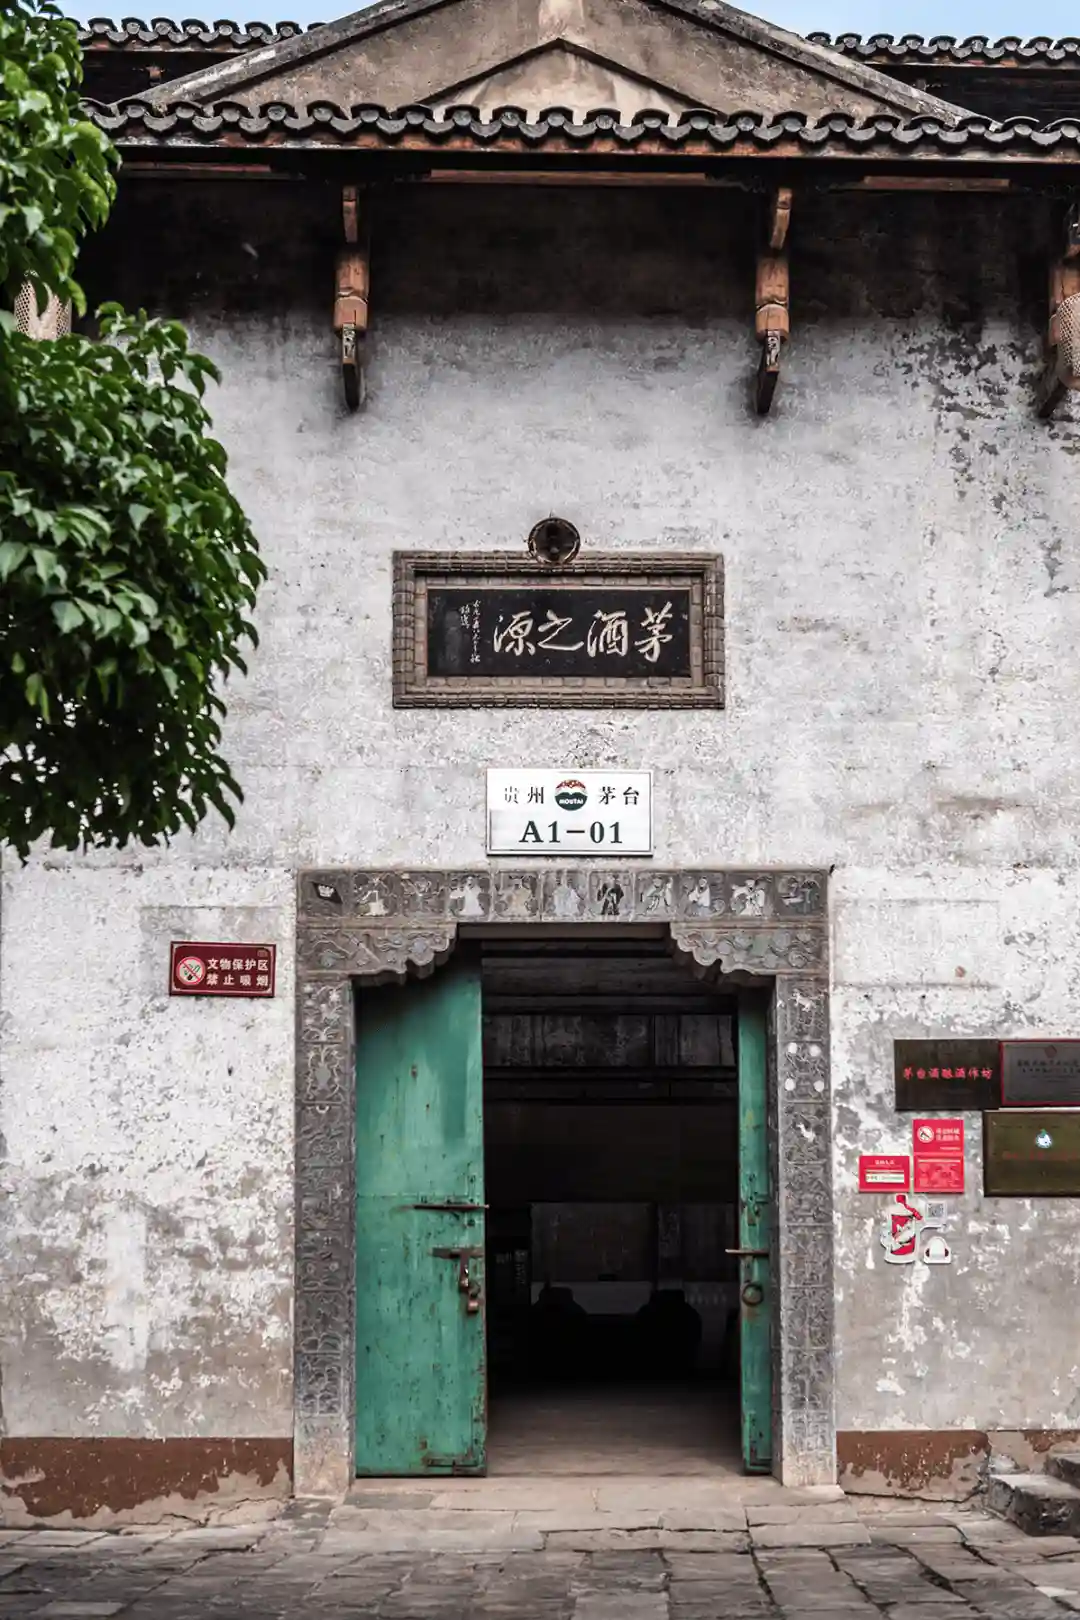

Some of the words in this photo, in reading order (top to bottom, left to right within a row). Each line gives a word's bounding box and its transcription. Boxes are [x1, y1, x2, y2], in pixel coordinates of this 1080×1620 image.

[493, 601, 674, 663] 茅酒之源
[504, 786, 545, 805] 贵州
[598, 786, 640, 806] 茅台
[207, 957, 269, 971] 文物保护区
[206, 973, 269, 986] 禁止吸烟
